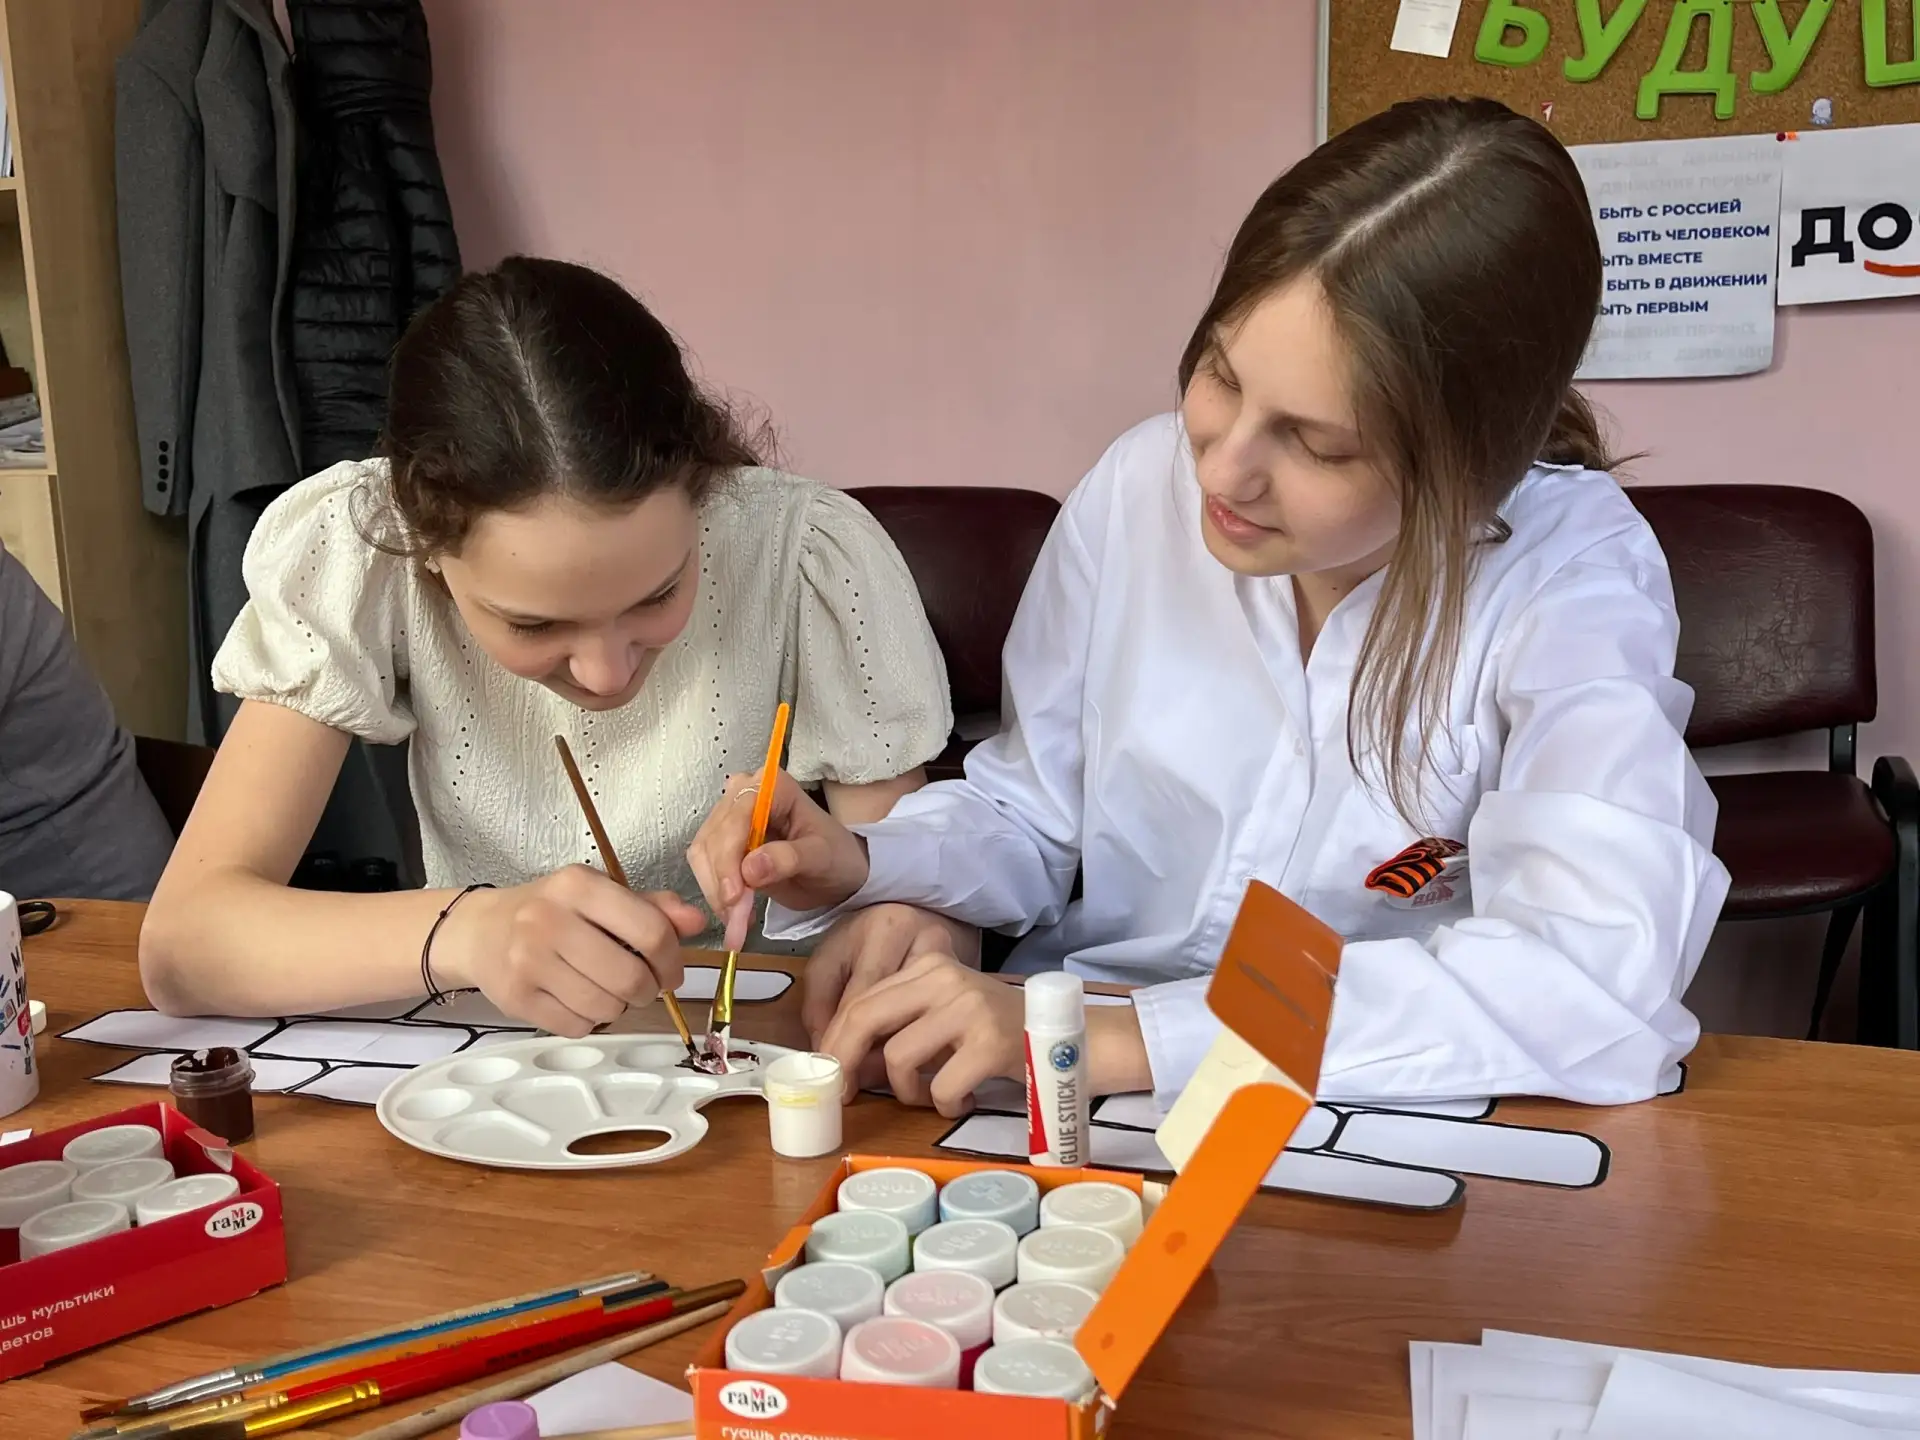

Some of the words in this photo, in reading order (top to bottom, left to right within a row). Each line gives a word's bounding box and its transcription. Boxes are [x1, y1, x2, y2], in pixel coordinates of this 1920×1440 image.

[1599, 206, 1643, 220] БЫТЬ
[1647, 205, 1658, 217] С
[1662, 198, 1742, 216] РОССИЕЙ
[1617, 229, 1662, 243] БЫТЬ
[1665, 225, 1770, 241] ЧЕЛОВЕКОМ
[1602, 254, 1633, 267] ЫТЬ
[1638, 251, 1703, 266] ВМЕСТЕ
[1606, 278, 1650, 292] БЫТЬ
[1655, 277, 1665, 289] В
[1669, 274, 1768, 291] ДВИЖЕНИИ
[1599, 302, 1632, 316] ЫТЬ
[1636, 300, 1709, 315] ПЕРВЫМ
[1057, 1077, 1078, 1123] STICK
[1059, 1125, 1079, 1165] GLUE
[32, 1284, 115, 1320] мультики
